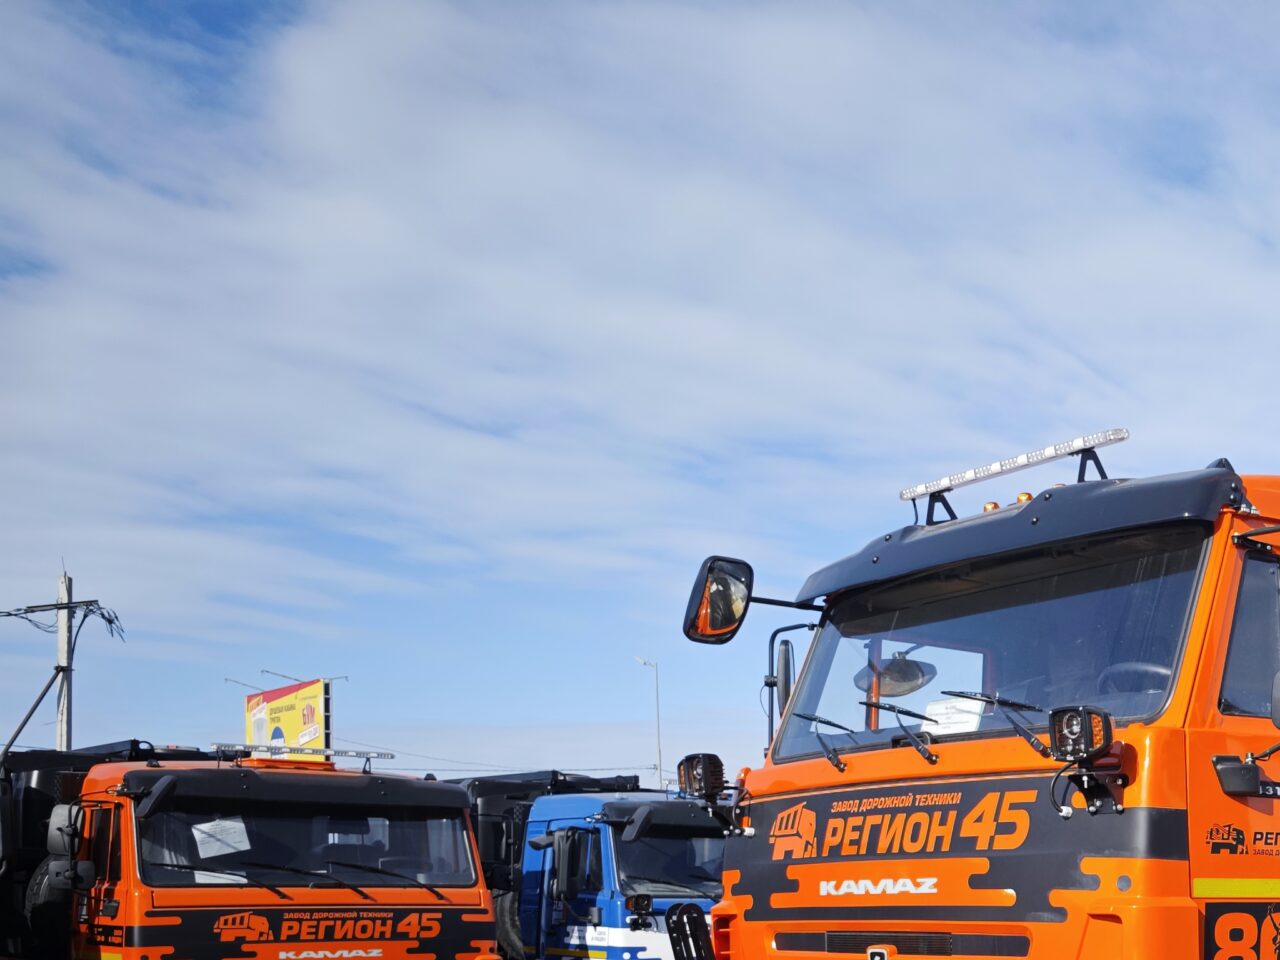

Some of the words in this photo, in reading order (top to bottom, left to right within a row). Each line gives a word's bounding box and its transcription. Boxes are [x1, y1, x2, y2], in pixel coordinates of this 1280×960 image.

[831, 801, 859, 813] ЗАВОД
[861, 793, 913, 811] ДОРОЖНОЙ
[915, 792, 962, 805] ТЕХНИКИ
[821, 810, 957, 857] РЕГИОН
[959, 789, 1038, 851] 45
[1252, 849, 1274, 857] ЗАВОД
[819, 877, 938, 896] KAMAZ
[312, 911, 358, 919] ДОРОЖНОЙ
[279, 919, 393, 941] РЕГИОН
[396, 912, 443, 939] 45
[278, 949, 383, 960] KAMAZ
